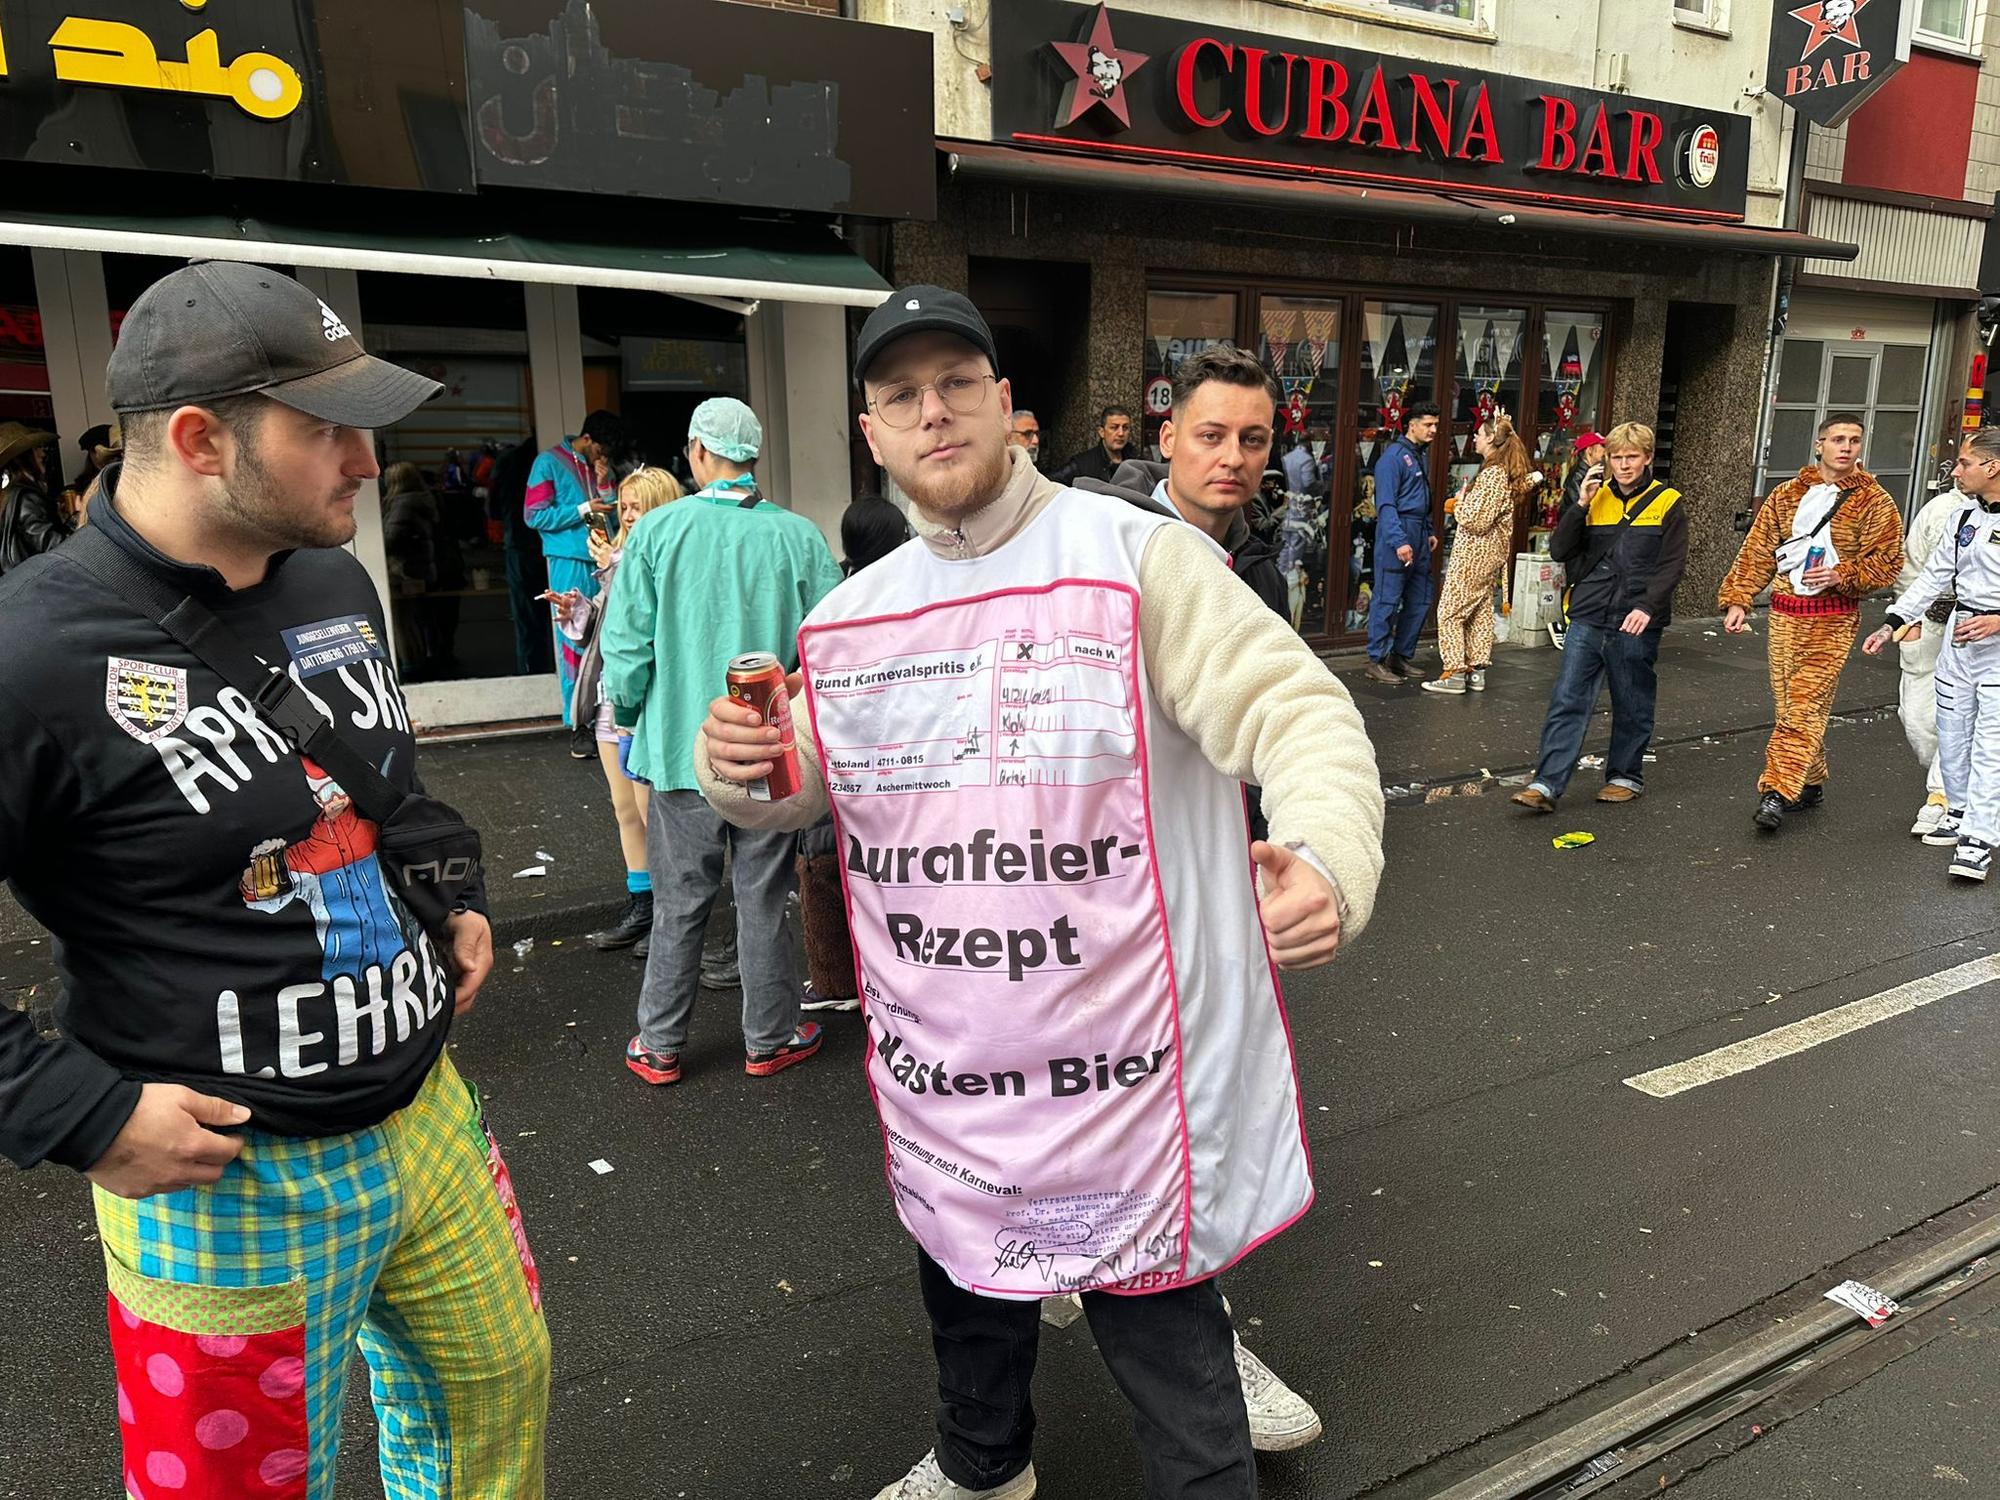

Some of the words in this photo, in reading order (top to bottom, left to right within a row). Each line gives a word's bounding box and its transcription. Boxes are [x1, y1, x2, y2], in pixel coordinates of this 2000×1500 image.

[1784, 51, 1872, 97] BAR
[1176, 37, 1503, 164] CUBANA
[1535, 94, 1663, 184] BAR
[1151, 386, 1170, 405] 18
[118, 659, 178, 676] SPORT-CLUB
[300, 648, 345, 669] DATTENBERG
[1075, 645, 1102, 657] nach
[816, 676, 851, 690] Bund
[855, 662, 965, 686] Karnevalspritis
[107, 666, 121, 719] ROT-WEISS
[120, 720, 143, 737] 1922
[165, 677, 186, 732] DATTENBERG
[876, 779, 951, 792] Aschermittwoch
[886, 913, 1081, 981] Rezept
[217, 929, 447, 1079] LEHRE
[1048, 1045, 1170, 1097] Bier
[934, 1157, 959, 1176] nach
[958, 1167, 1022, 1196] Karneval:
[1035, 1208, 1050, 1216] Dr.
